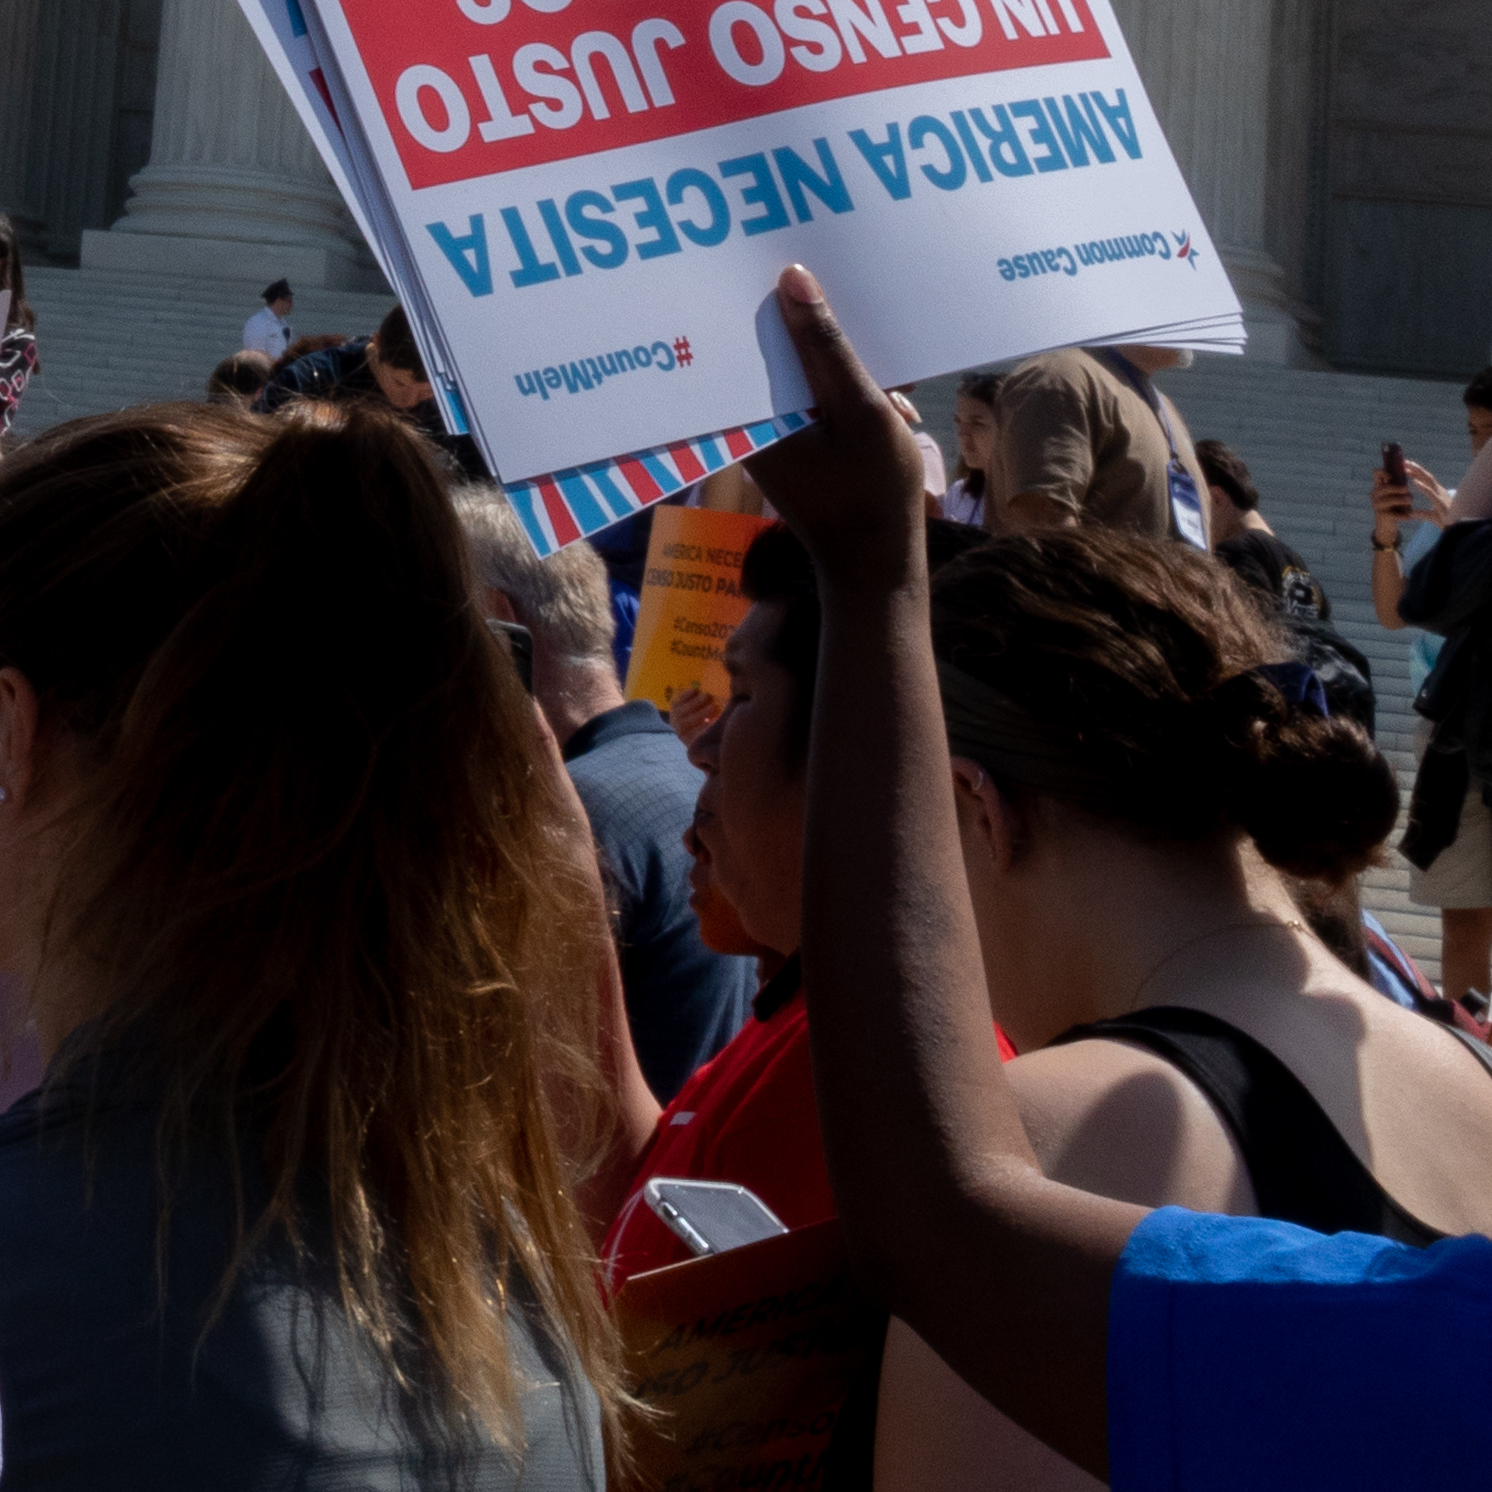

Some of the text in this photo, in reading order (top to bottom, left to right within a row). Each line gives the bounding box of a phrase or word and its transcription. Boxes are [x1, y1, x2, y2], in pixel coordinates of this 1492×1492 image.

[394, 17, 686, 153] JUSTO
[425, 87, 1144, 298] AMERICA NECESITA
[996, 230, 1174, 282] Common Cause
[514, 336, 694, 401] #CountMeIn
[706, 547, 743, 570] NECE
